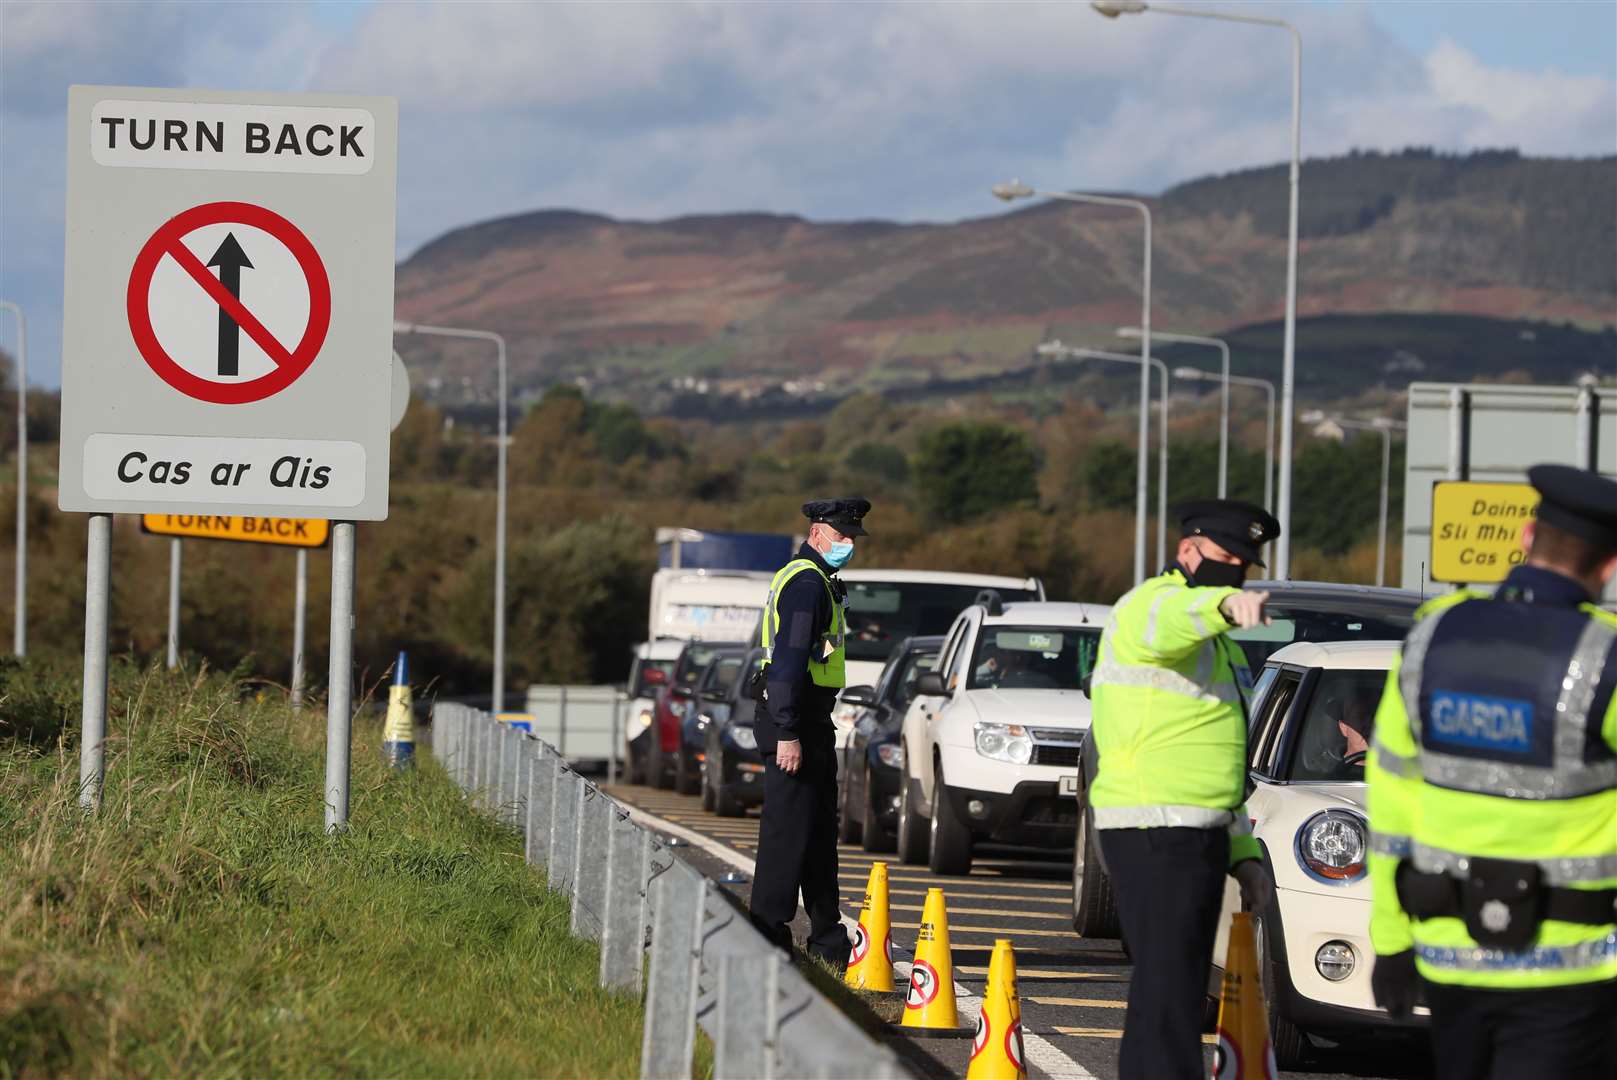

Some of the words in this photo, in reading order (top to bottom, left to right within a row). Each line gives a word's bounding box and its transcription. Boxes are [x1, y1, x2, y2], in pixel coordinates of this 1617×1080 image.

[101, 117, 224, 152] TURN
[245, 122, 365, 157] BACK
[117, 451, 192, 485] Cas
[210, 463, 252, 486] ar
[269, 455, 332, 489] Ais
[242, 516, 308, 537] BACK
[1459, 547, 1498, 566] Cas
[1431, 697, 1529, 743] GARDA
